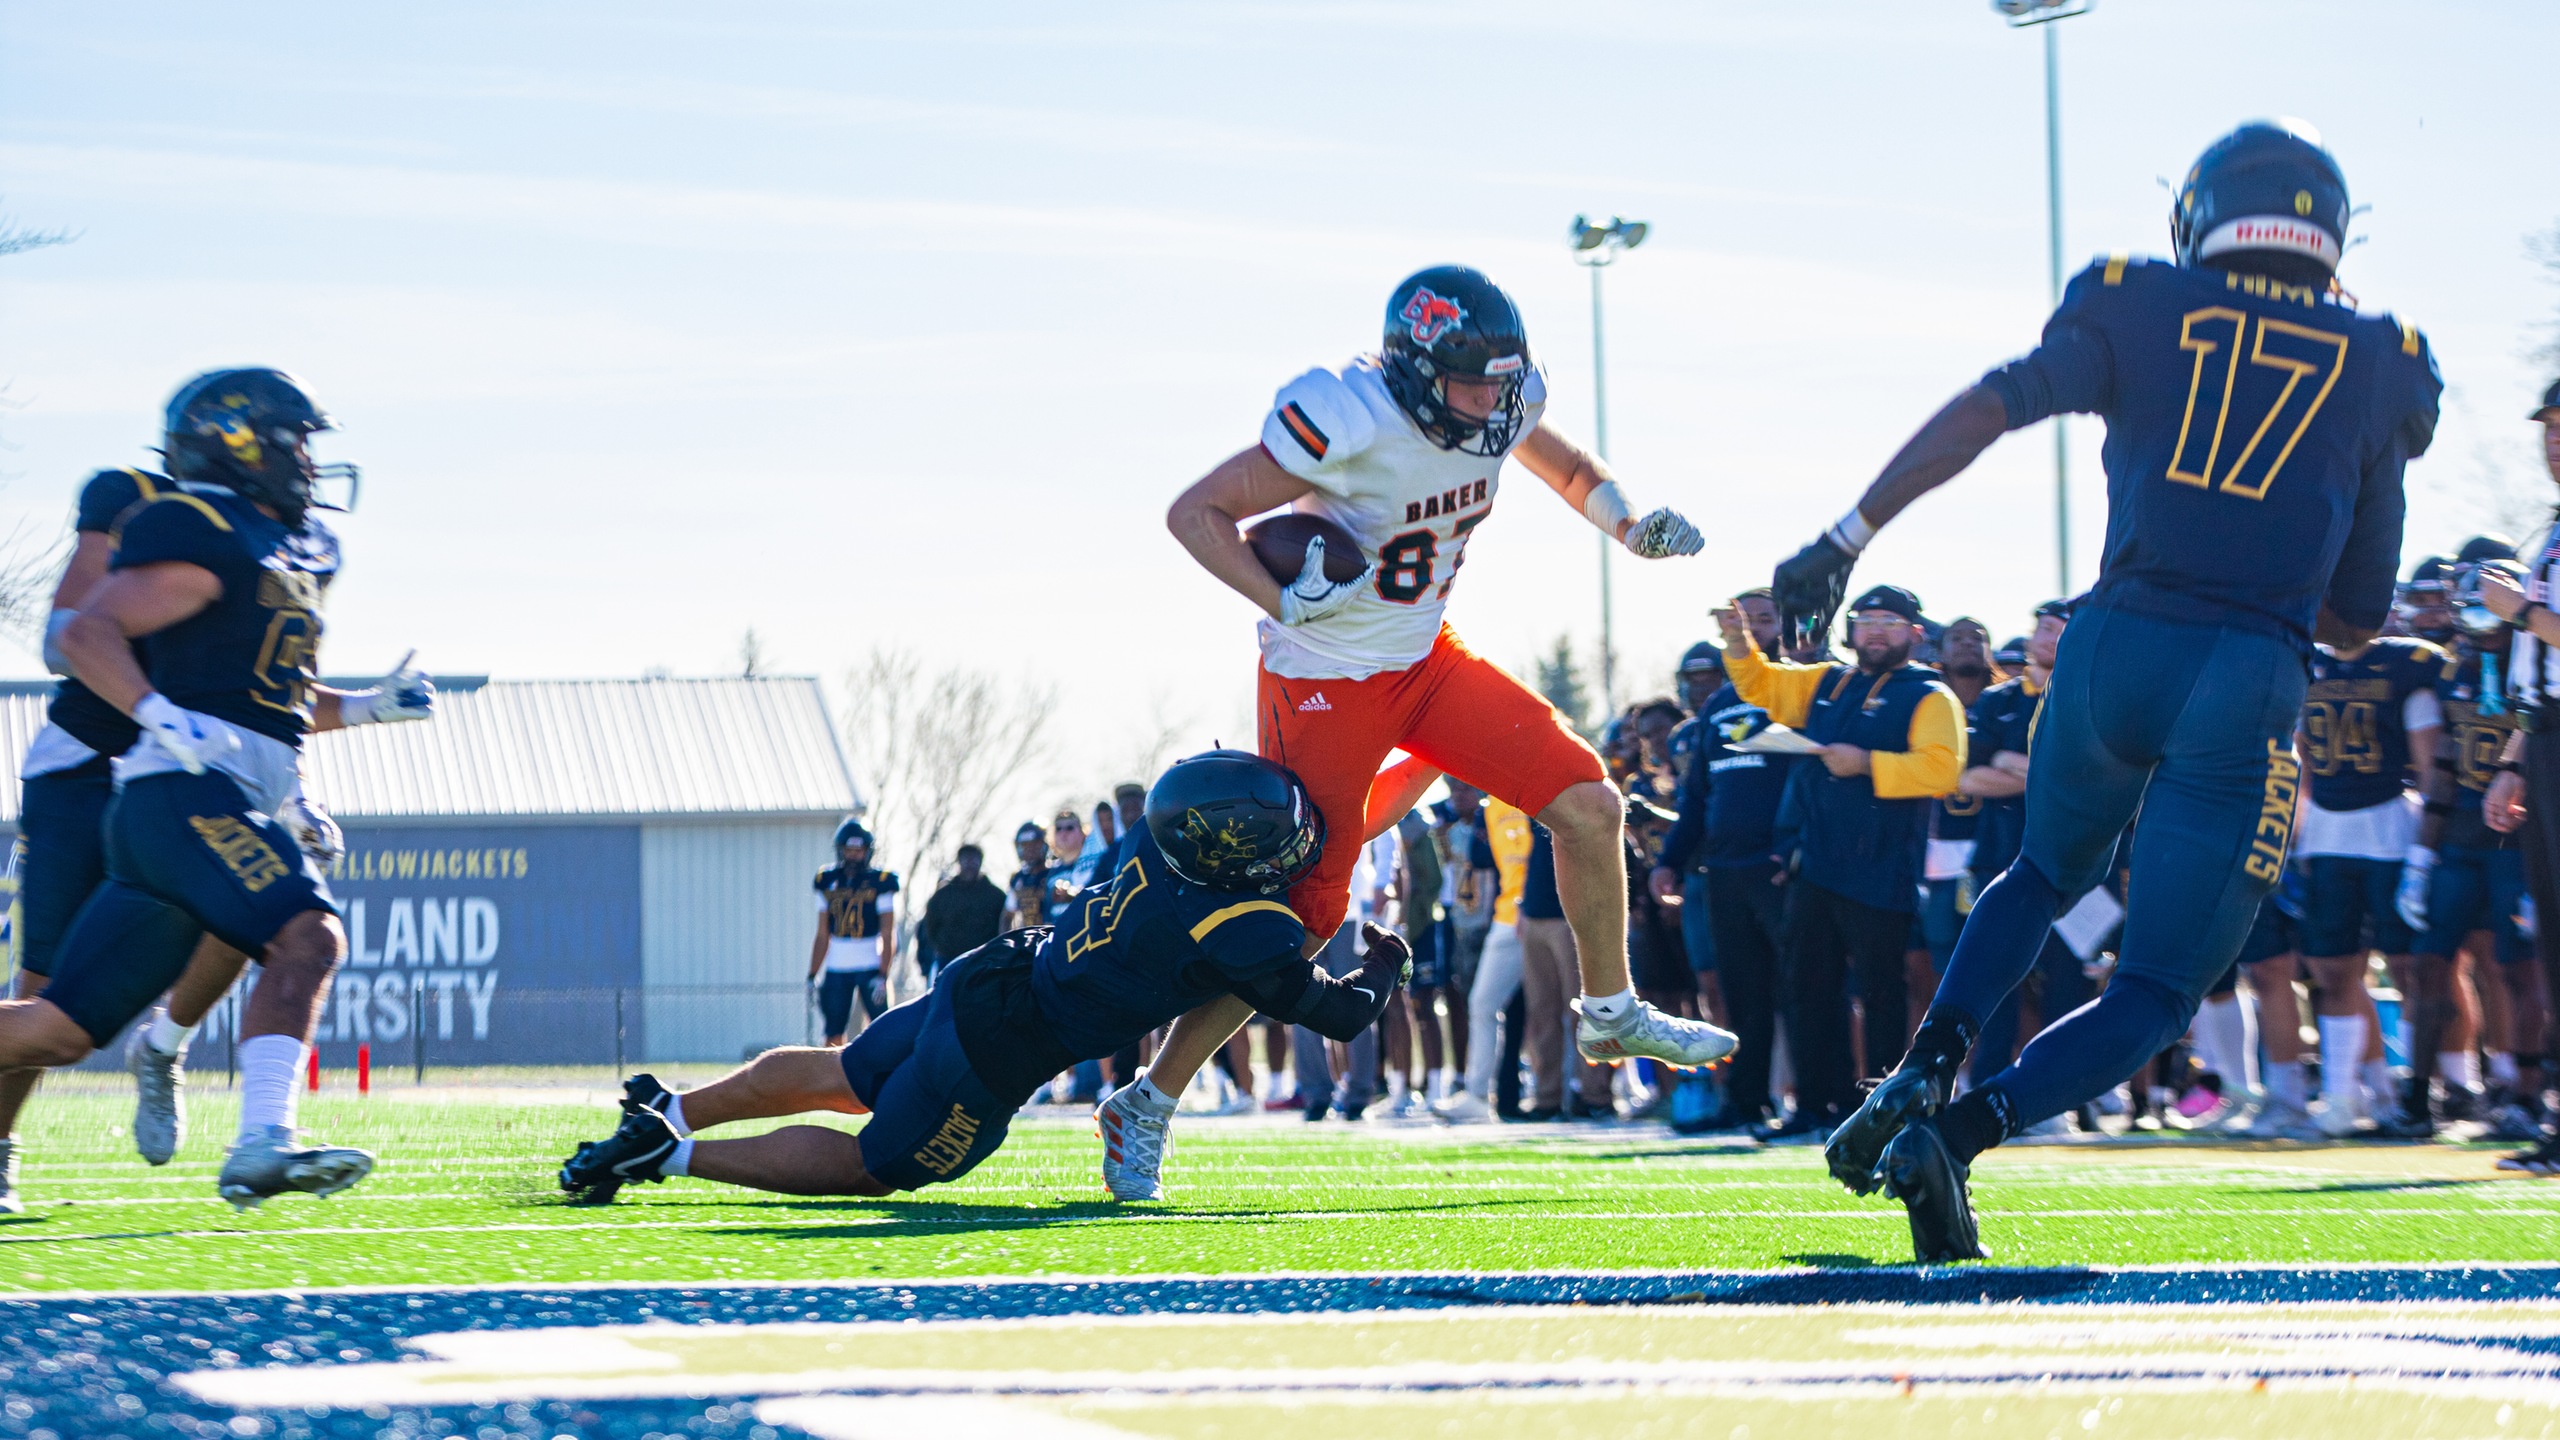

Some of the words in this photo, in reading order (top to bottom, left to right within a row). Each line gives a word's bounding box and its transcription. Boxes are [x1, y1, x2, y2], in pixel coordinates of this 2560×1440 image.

[2166, 305, 2349, 501] 17
[1404, 477, 1488, 524] BAKER
[1373, 502, 1492, 605] 87
[1298, 702, 1332, 712] adidas
[2244, 737, 2299, 886] JACKETS
[324, 848, 529, 881] ELLOWJACKETS
[336, 896, 499, 968] LAND
[913, 1102, 981, 1176] JACKETS
